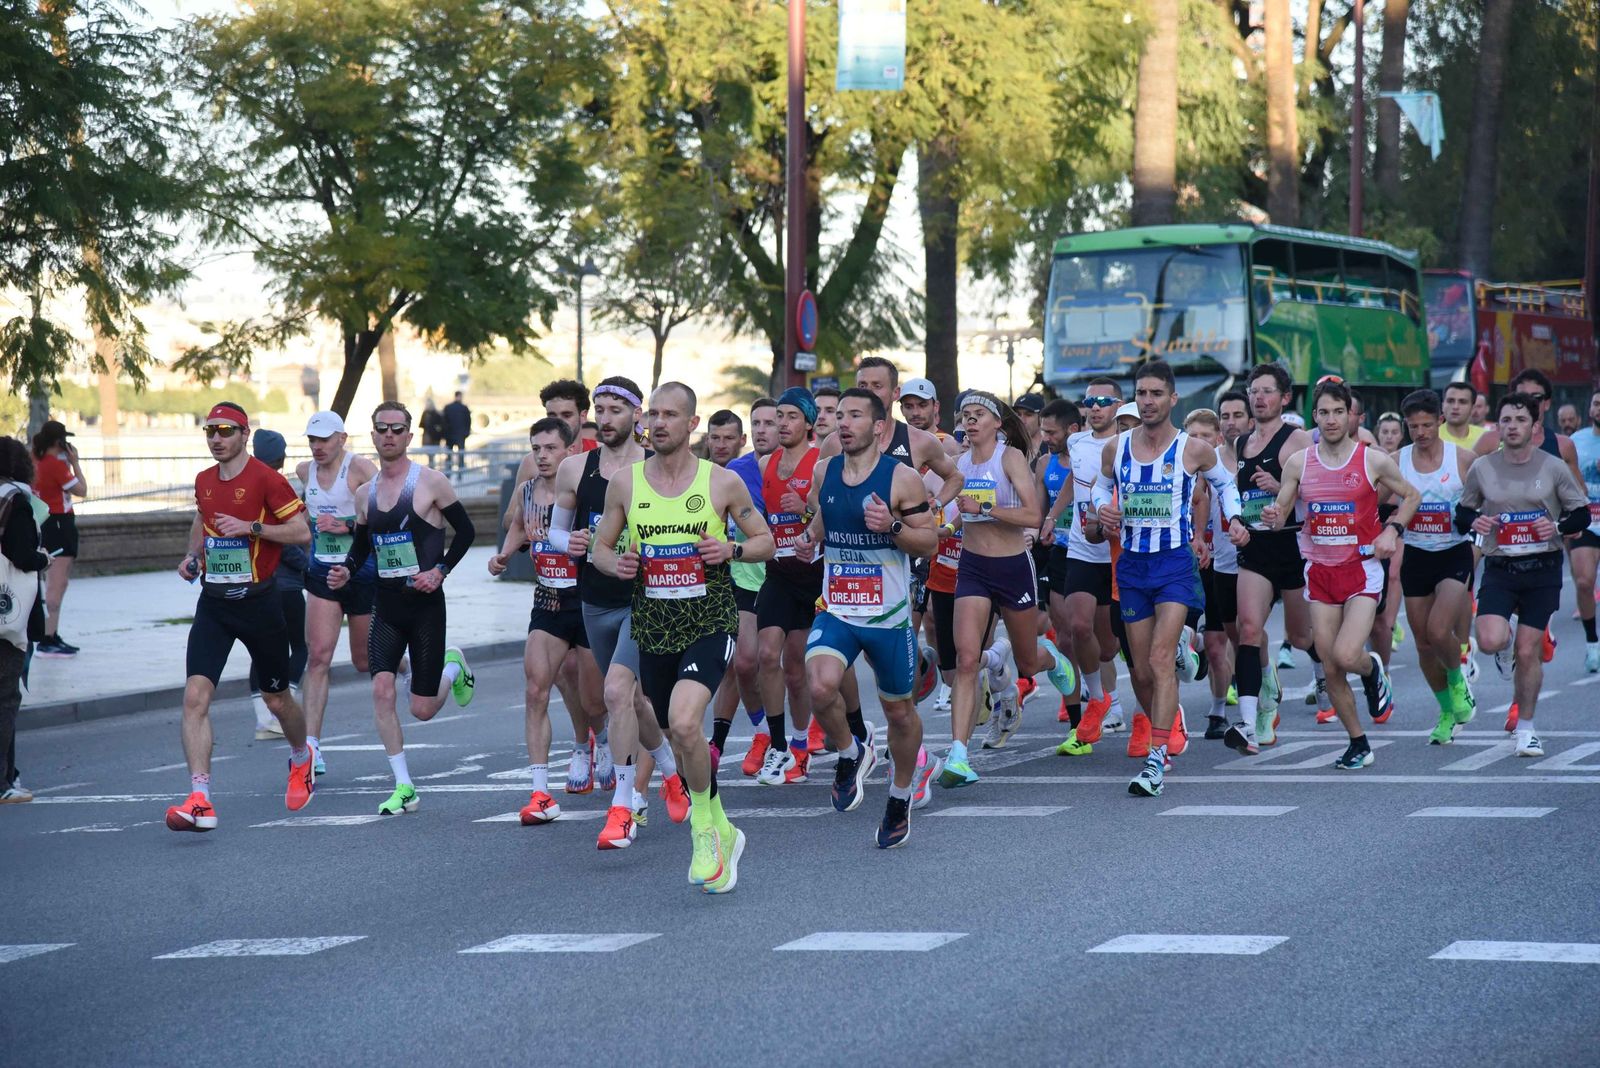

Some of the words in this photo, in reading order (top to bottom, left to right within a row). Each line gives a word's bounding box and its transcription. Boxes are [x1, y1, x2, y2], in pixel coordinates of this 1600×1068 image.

[1251, 490, 1273, 498] ZURIC
[1124, 507, 1171, 517] AIRAMMIA
[1513, 513, 1540, 521] ZURICH
[636, 521, 708, 540] DEPORTEMANIA
[1316, 525, 1348, 535] SERGIO
[1413, 523, 1444, 533] JUANKI
[1511, 534, 1535, 543] PAUL
[325, 544, 342, 553] TOM
[658, 546, 694, 556] ZURICH
[211, 562, 242, 573] VICTOR
[663, 563, 678, 571] 830
[844, 567, 875, 575] ZURICH
[648, 573, 698, 586] MARCOS
[847, 582, 860, 590] 815
[831, 591, 880, 604] OREJUELA
